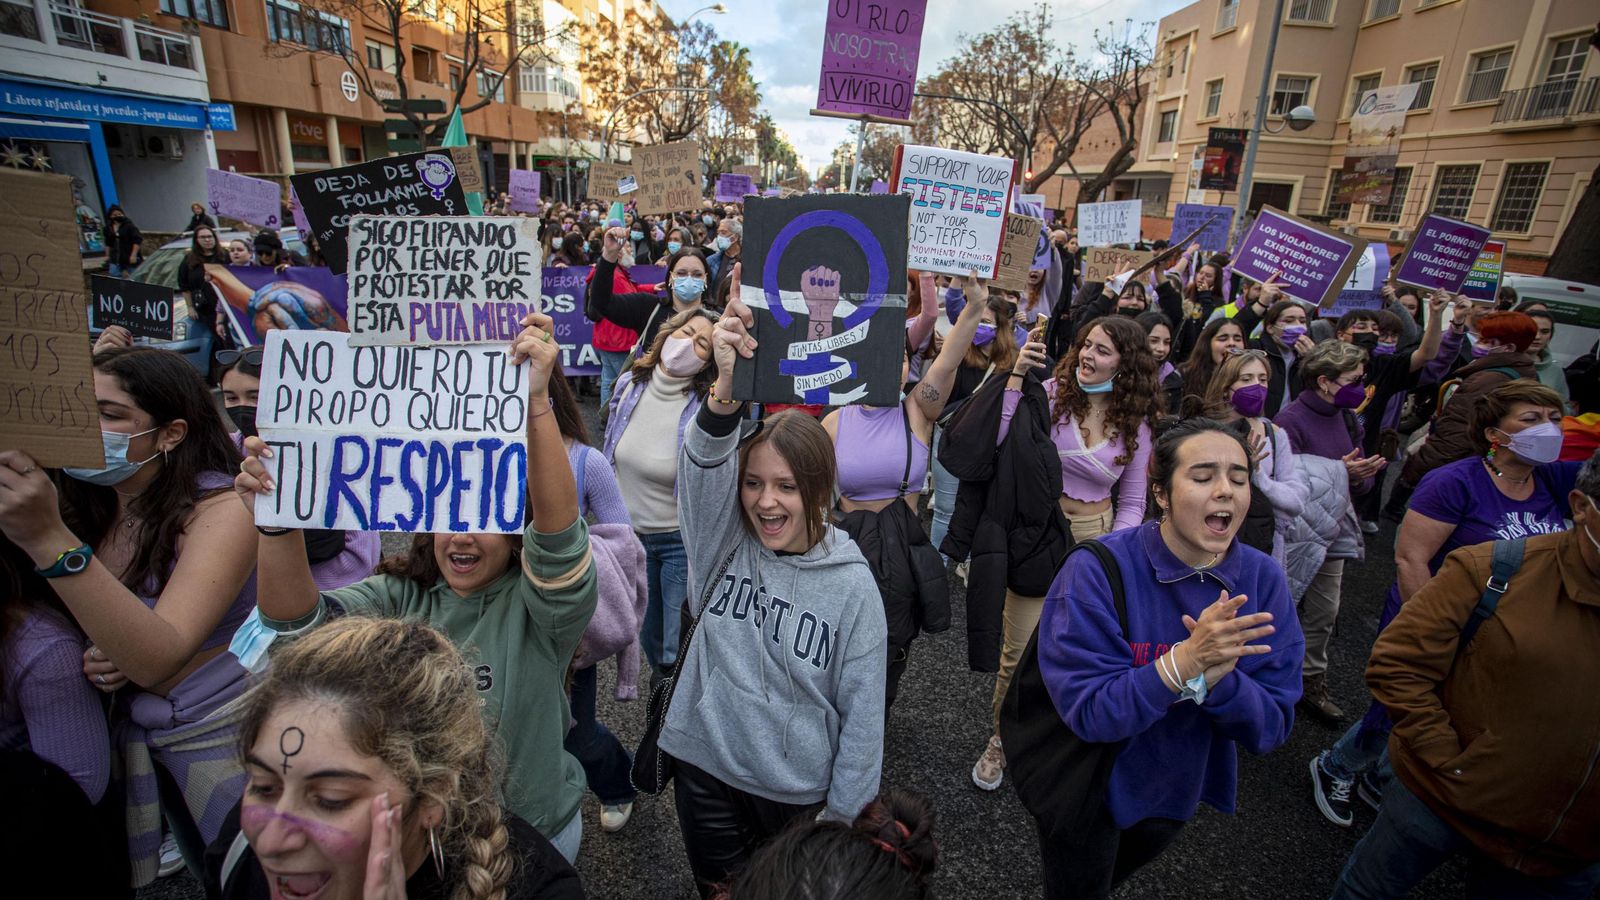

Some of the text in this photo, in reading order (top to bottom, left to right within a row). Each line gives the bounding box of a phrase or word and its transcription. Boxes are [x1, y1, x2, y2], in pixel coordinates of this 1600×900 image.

[5, 92, 42, 107] Libros
[293, 121, 323, 140] rtve
[314, 163, 414, 193] DEJA DE
[908, 154, 1010, 188] SUPPORT YOUR
[337, 182, 429, 209] FOLLARME
[900, 177, 1004, 218] SISTERS
[359, 218, 517, 250] SIGO FLIPANDO
[916, 212, 969, 228] NOT YOUR
[1259, 224, 1340, 261] LOS VIOLADORES
[1425, 229, 1437, 238] EL
[1439, 232, 1468, 246] PORNO
[355, 246, 532, 280] POR TENER QUE
[914, 255, 928, 265] SER
[959, 250, 993, 262] FEMINISTA
[1250, 246, 1324, 281] ANTES QUE LAS
[1263, 239, 1321, 267] EXISTIERON
[354, 272, 529, 300] PROTESTAR POR
[541, 275, 586, 289] IVERSAS
[1252, 259, 1309, 288] MINIFALDAS
[100, 294, 124, 314] NO
[145, 300, 169, 322] NO
[354, 300, 537, 341] ESTA PUTA MIERD
[827, 331, 857, 351] LIBRES
[859, 326, 865, 339] Y
[280, 338, 520, 396] NO QUIERO TU
[796, 369, 843, 391] SIN MIEDO
[274, 384, 525, 433] PIROPO QUIERO
[265, 435, 528, 532] TU RESPETO
[709, 574, 838, 670] BOSTON
